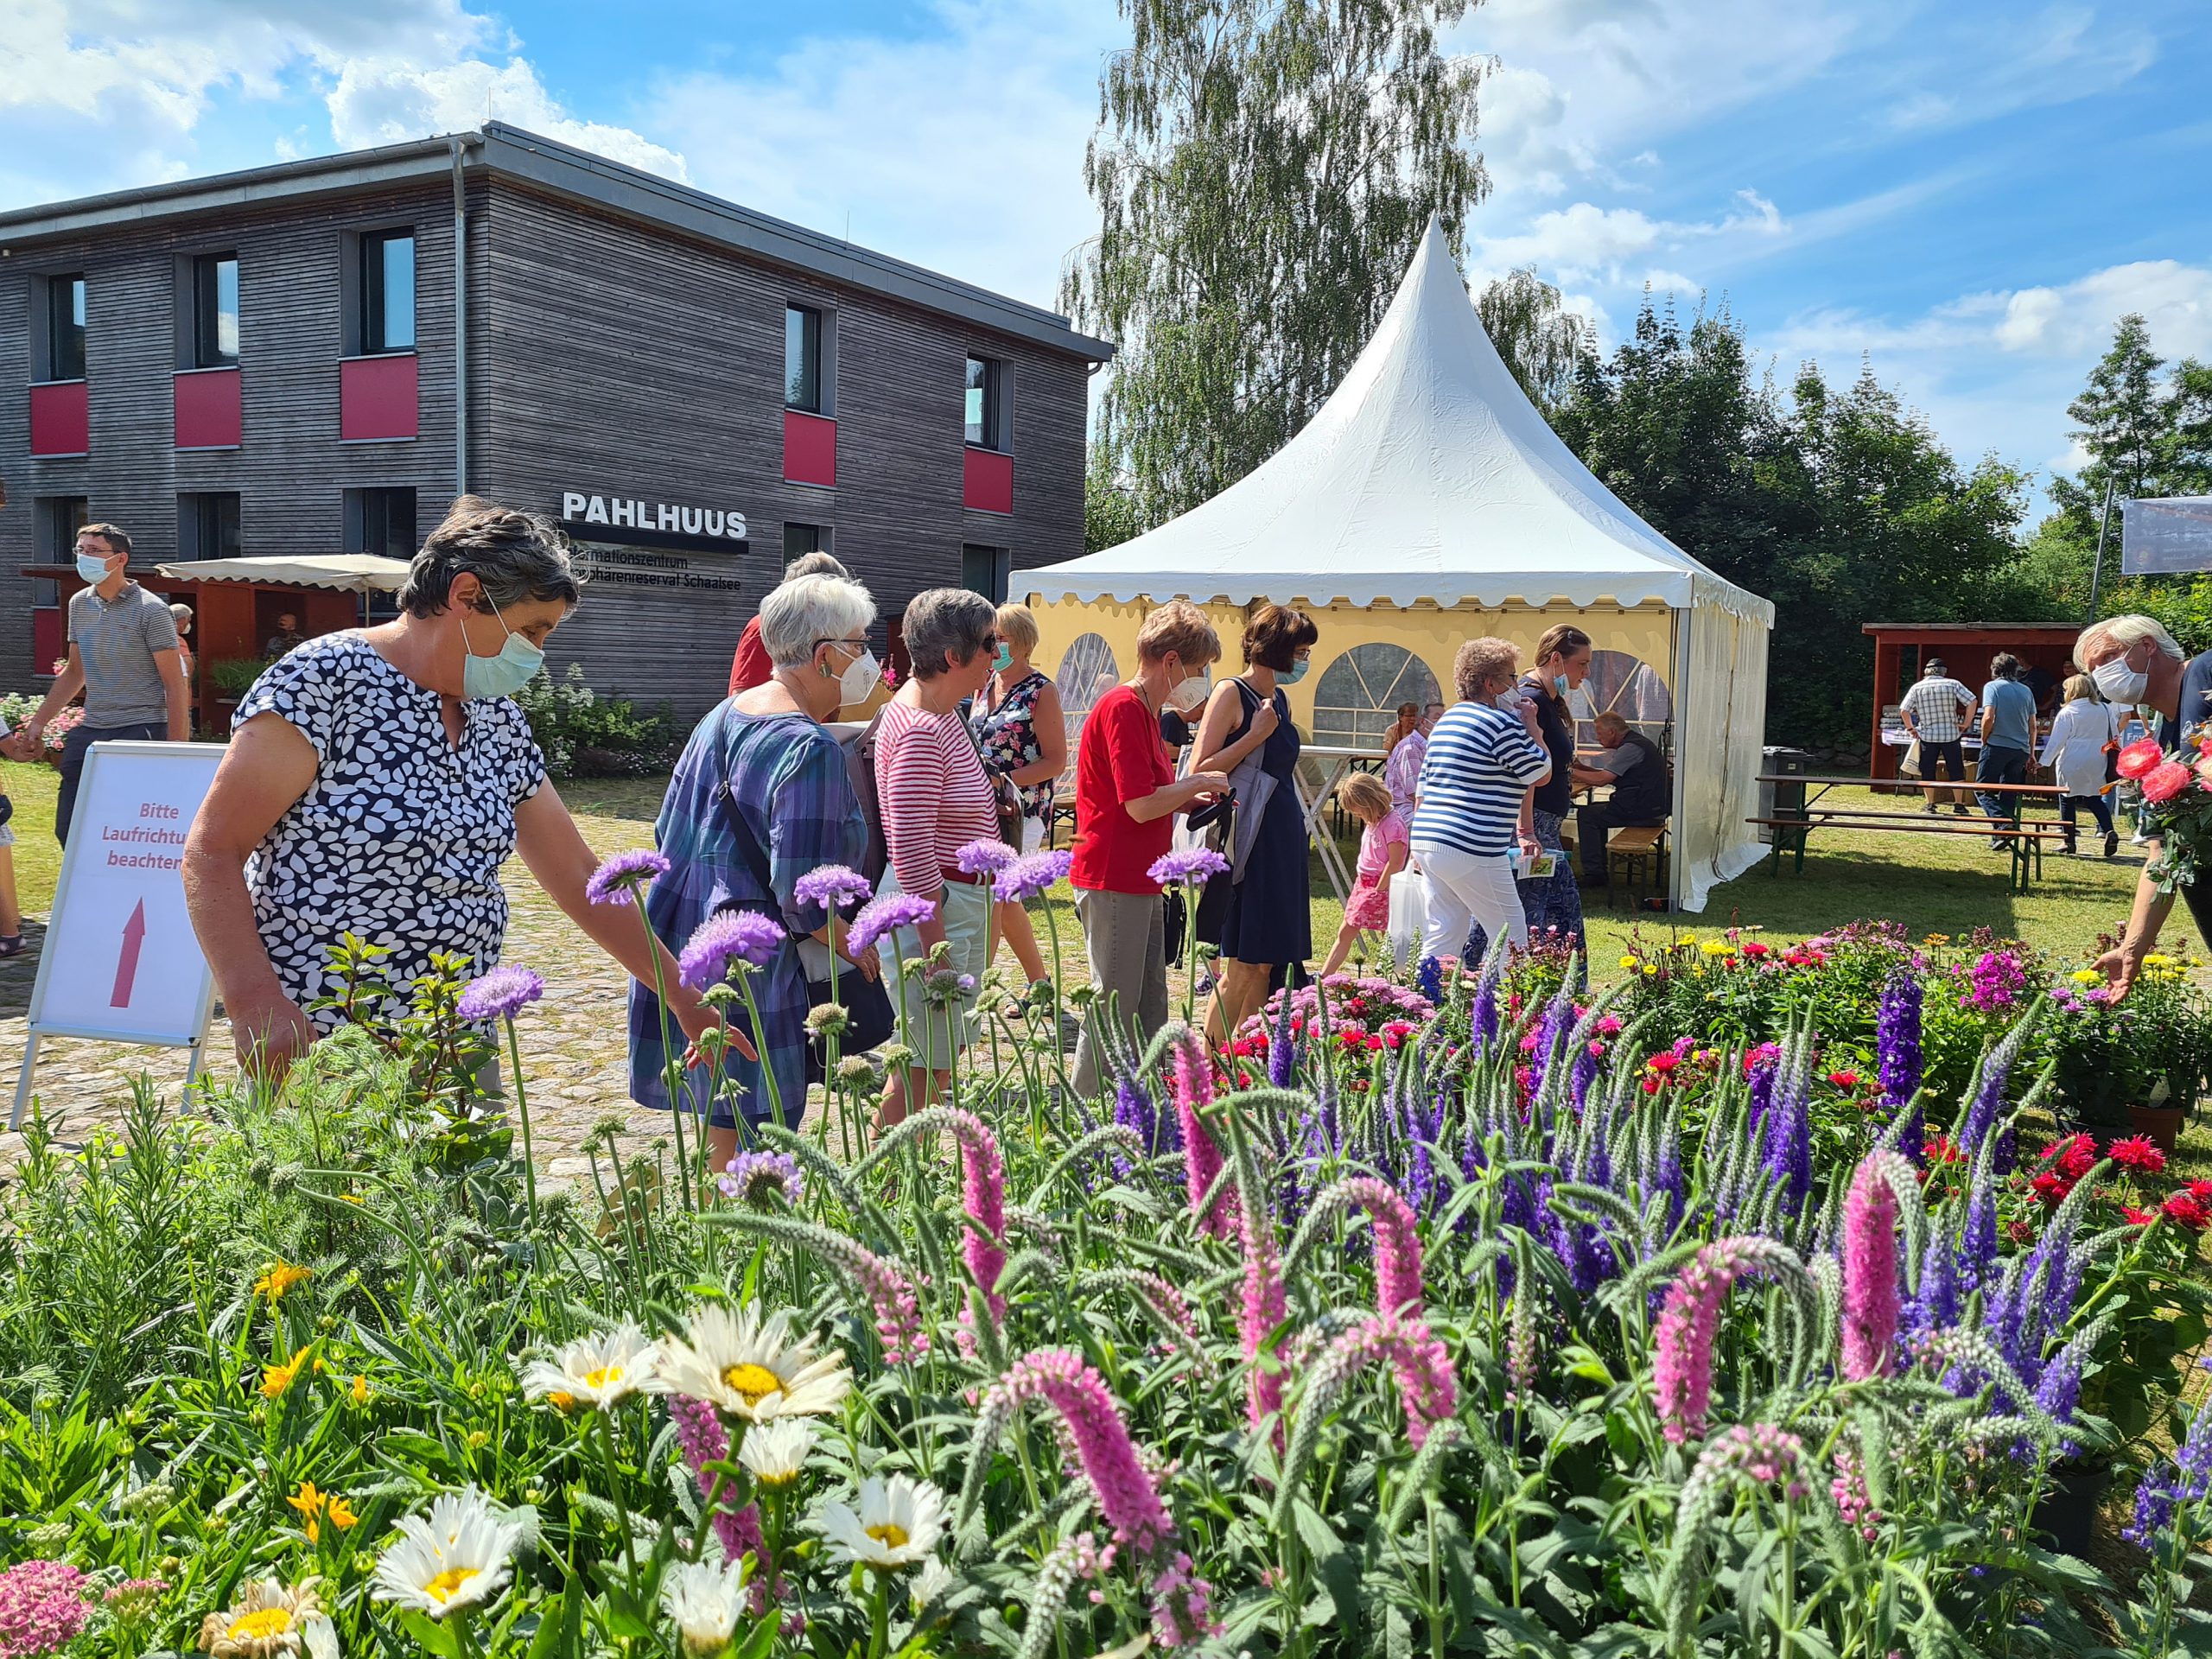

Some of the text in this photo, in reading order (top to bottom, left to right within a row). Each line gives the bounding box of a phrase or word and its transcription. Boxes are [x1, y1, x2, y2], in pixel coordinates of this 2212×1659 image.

[563, 492, 747, 539] PAHLHUUS
[568, 545, 688, 569] formationszentrum
[683, 573, 741, 590] Schaalsee
[139, 802, 180, 820] Bitte
[102, 826, 187, 845] Laufrichtu
